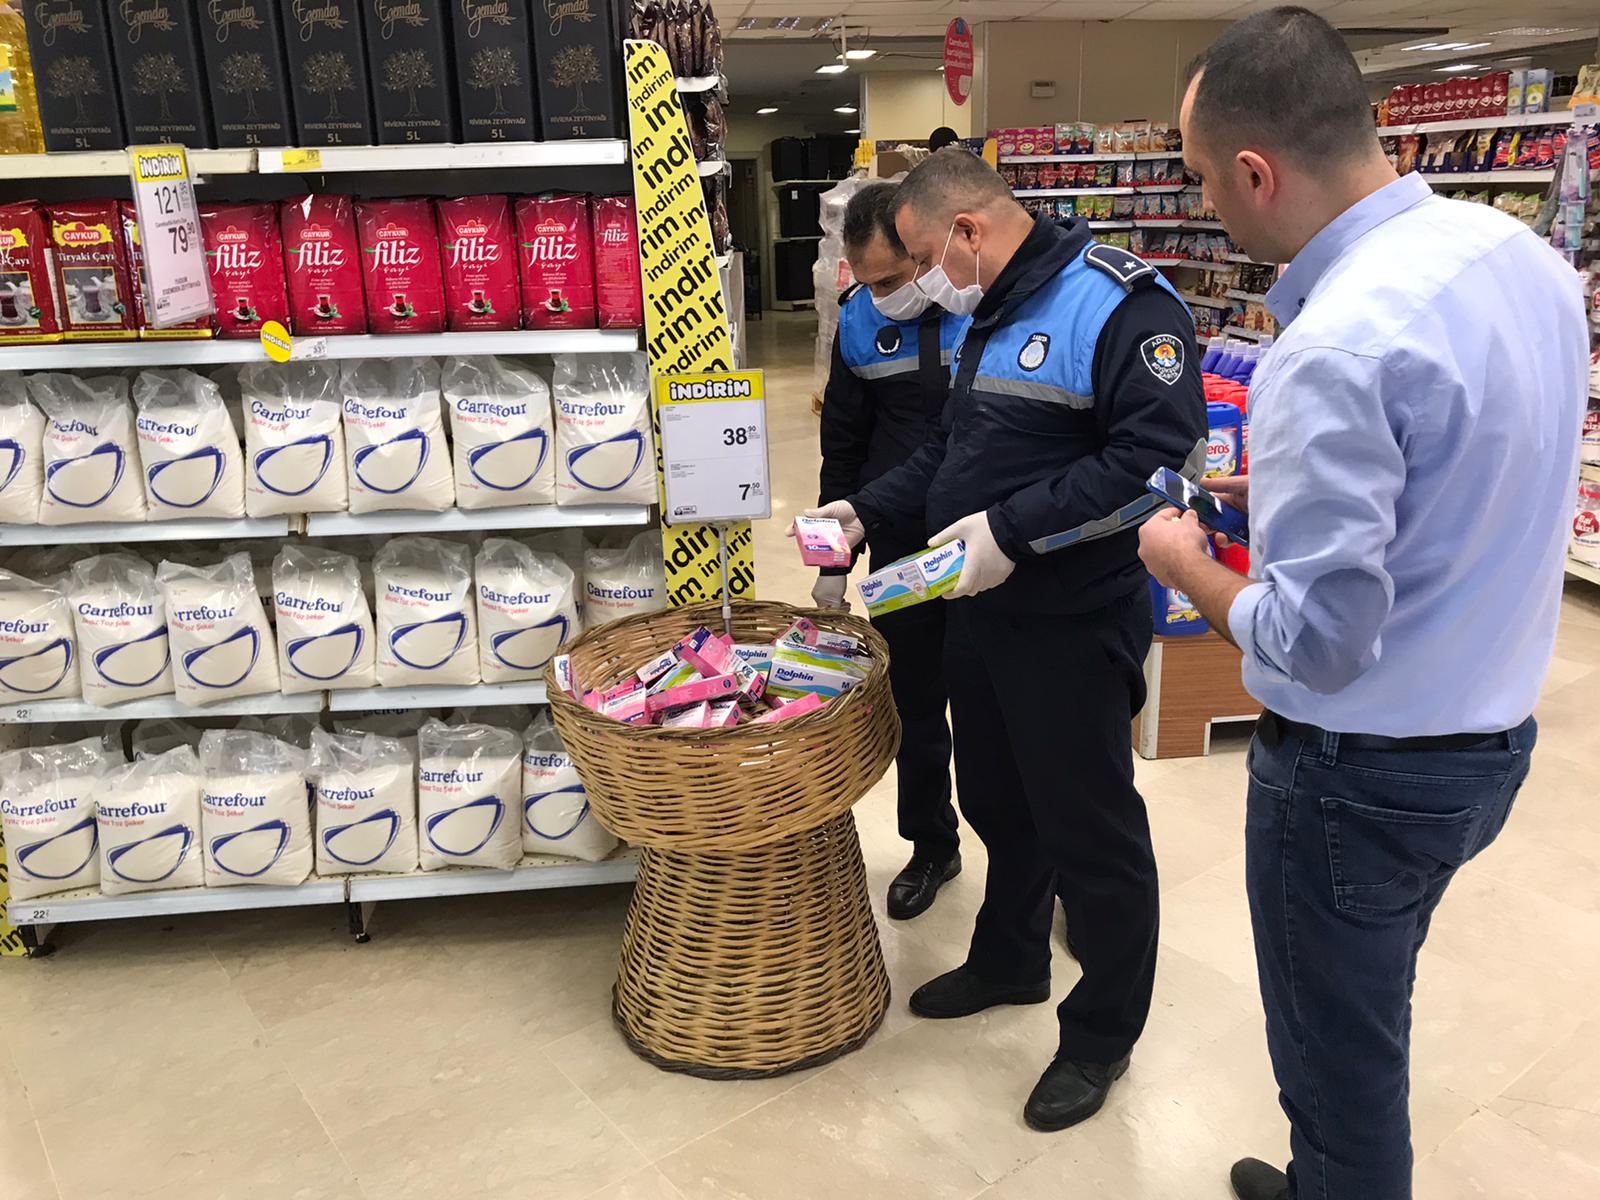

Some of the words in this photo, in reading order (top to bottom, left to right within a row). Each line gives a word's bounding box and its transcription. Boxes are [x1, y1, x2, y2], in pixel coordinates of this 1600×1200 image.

[34, 1, 84, 46] Egemden
[119, 0, 170, 44] Egemden
[207, 0, 257, 43] Egemden
[630, 69, 672, 109] indirim
[638, 172, 695, 226] indirim
[603, 229, 629, 247] filiz
[58, 252, 91, 263] Tiryaki
[92, 252, 114, 263] Çayı
[214, 243, 262, 276] filiz
[294, 241, 345, 273] filiz
[370, 240, 421, 273] filiz
[450, 237, 499, 269] filiz
[528, 236, 578, 268] filiz
[644, 232, 700, 283] indirim
[1151, 336, 1176, 347] ADANA
[456, 398, 528, 418] Carrefour
[1206, 444, 1230, 455] eros
[923, 549, 953, 570] Dolphin
[480, 585, 551, 605] Carrefour
[587, 582, 654, 599] Carrefour
[861, 579, 884, 593] Dolphin
[735, 649, 768, 661] Dolphin
[777, 667, 814, 681] Dolphin
[1, 797, 78, 816] Carrefour
